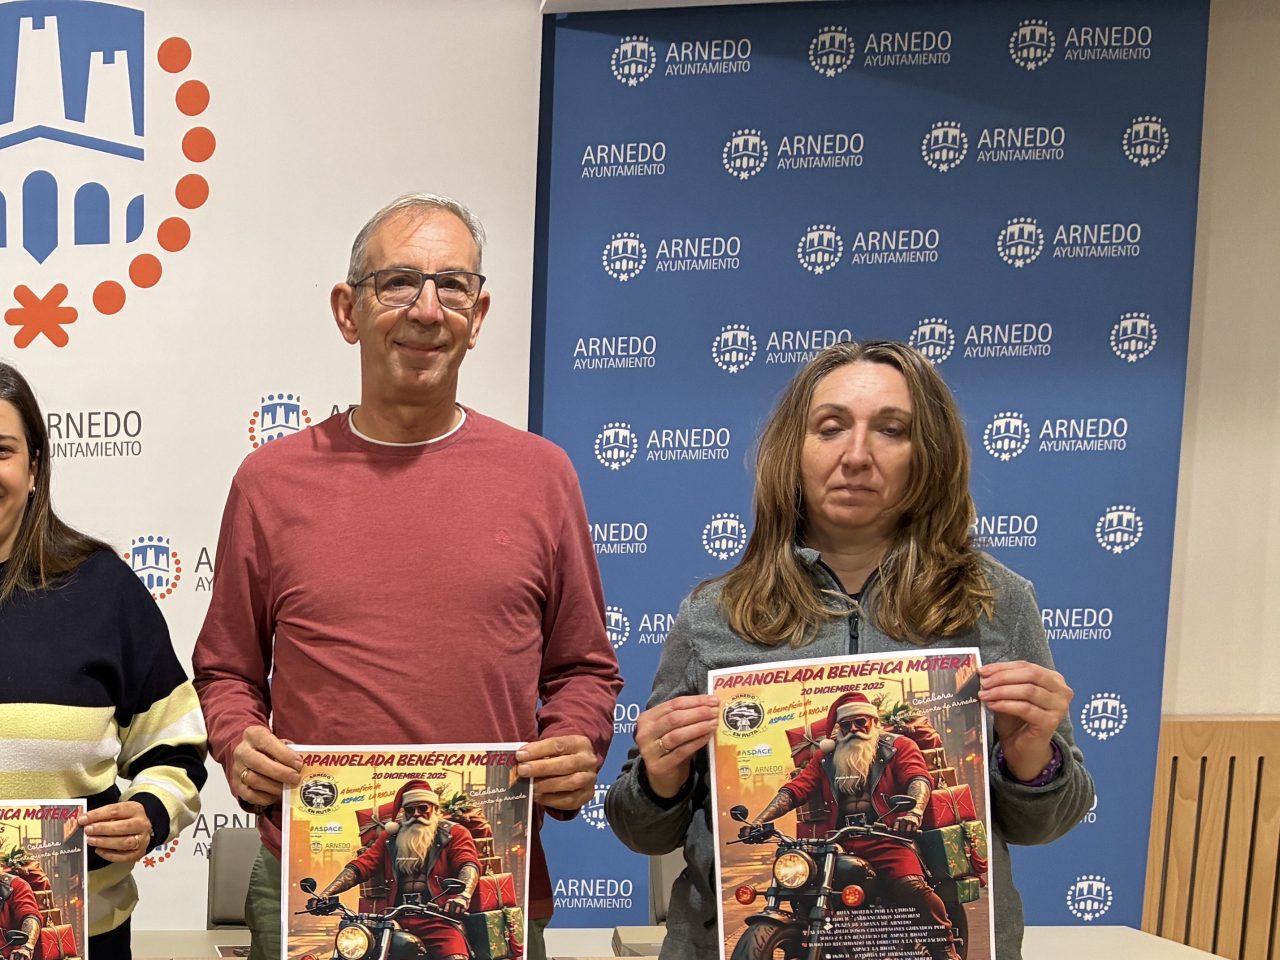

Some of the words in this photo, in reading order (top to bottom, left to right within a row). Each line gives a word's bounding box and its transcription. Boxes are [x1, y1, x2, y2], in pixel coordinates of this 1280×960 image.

[864, 31, 951, 53] ARNEDO
[1065, 26, 1151, 47] ARNEDO
[666, 39, 751, 62] ARNEDO
[1065, 48, 1150, 60] AYUNTAMIENTO
[864, 53, 950, 66] AYUNTAMIENTO
[665, 61, 750, 75] AYUNTAMIENTO
[778, 134, 863, 156] ARNEDO
[978, 127, 1065, 148] ARNEDO
[582, 142, 665, 165] ARNEDO
[977, 148, 1063, 161] AYUNTAMIENTO
[777, 155, 862, 169] AYUNTAMIENTO
[582, 164, 665, 178] AYUNTAMIENTO
[852, 229, 939, 251] ARNEDO
[1054, 224, 1140, 244] ARNEDO
[656, 237, 740, 258] ARNEDO
[1053, 245, 1139, 257] AYUNTAMIENTO
[656, 258, 739, 271] AYUNTAMIENTO
[852, 251, 938, 264] AYUNTAMIENTO
[964, 323, 1052, 344] ARNEDO
[574, 336, 656, 356] ARNEDO
[964, 344, 1050, 357] AYUNTAMIENTO
[574, 357, 655, 369] AYUNTAMIENTO
[47, 410, 142, 439] RNEDO
[1040, 418, 1127, 438] ARNEDO
[647, 428, 729, 448] ARNEDO
[1039, 439, 1126, 451] AYUNTAMIENTO
[50, 440, 142, 458] UNTAMIENTO
[647, 449, 729, 460] AYUNTAMIENTO
[588, 523, 648, 542] NEDO
[969, 514, 1038, 535] RNEDO
[593, 543, 646, 554] TAMIENTO
[1041, 608, 1113, 628] RNEDO
[1045, 629, 1112, 640] NTAMIENTO
[714, 667, 825, 690] PAPANOELADA
[827, 660, 904, 680] BENÉFICA
[906, 655, 971, 673] MOTERA
[800, 688, 812, 696] 20
[813, 683, 862, 695] DICIEMBRE
[863, 681, 885, 690] 2025
[912, 692, 954, 706] Colabora
[300, 754, 395, 767] APANOELADA
[397, 751, 466, 767] BENÉFICA
[383, 772, 425, 780] DICIEMBRE
[23, 807, 80, 820] MOTERA
[554, 879, 632, 896] ARNEDO
[554, 898, 632, 908] AYUNTAMIENTO
